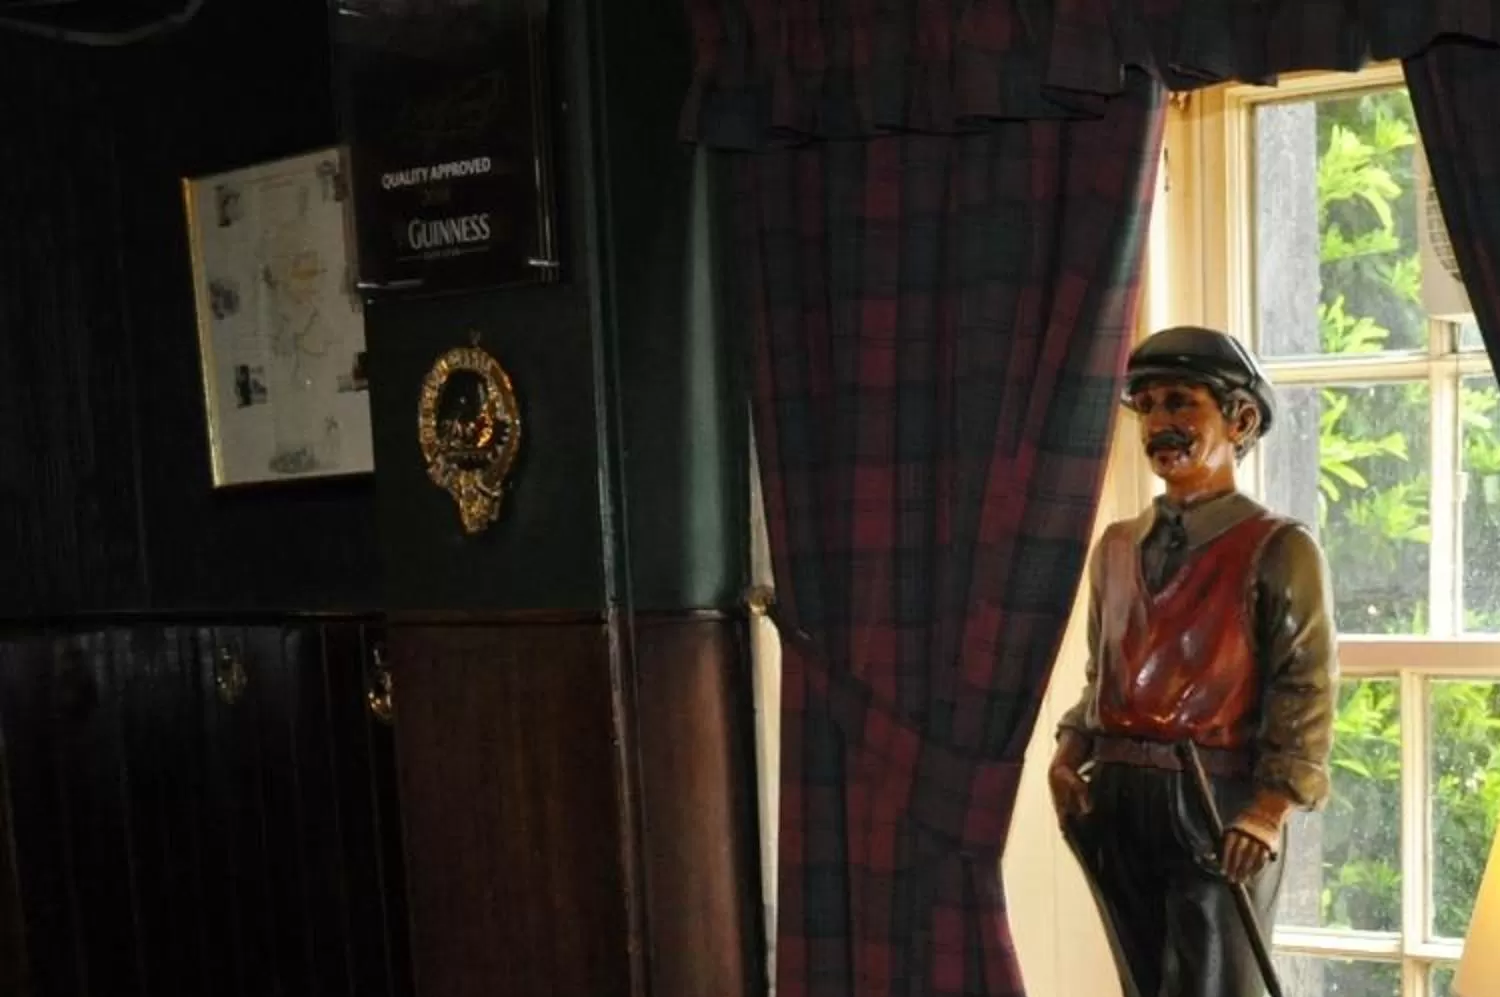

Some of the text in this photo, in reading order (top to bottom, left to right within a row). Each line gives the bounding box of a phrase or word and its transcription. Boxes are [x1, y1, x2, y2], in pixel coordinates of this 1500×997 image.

[381, 156, 492, 190] QUALITY APPROVED
[408, 213, 492, 250] GUINNESS
